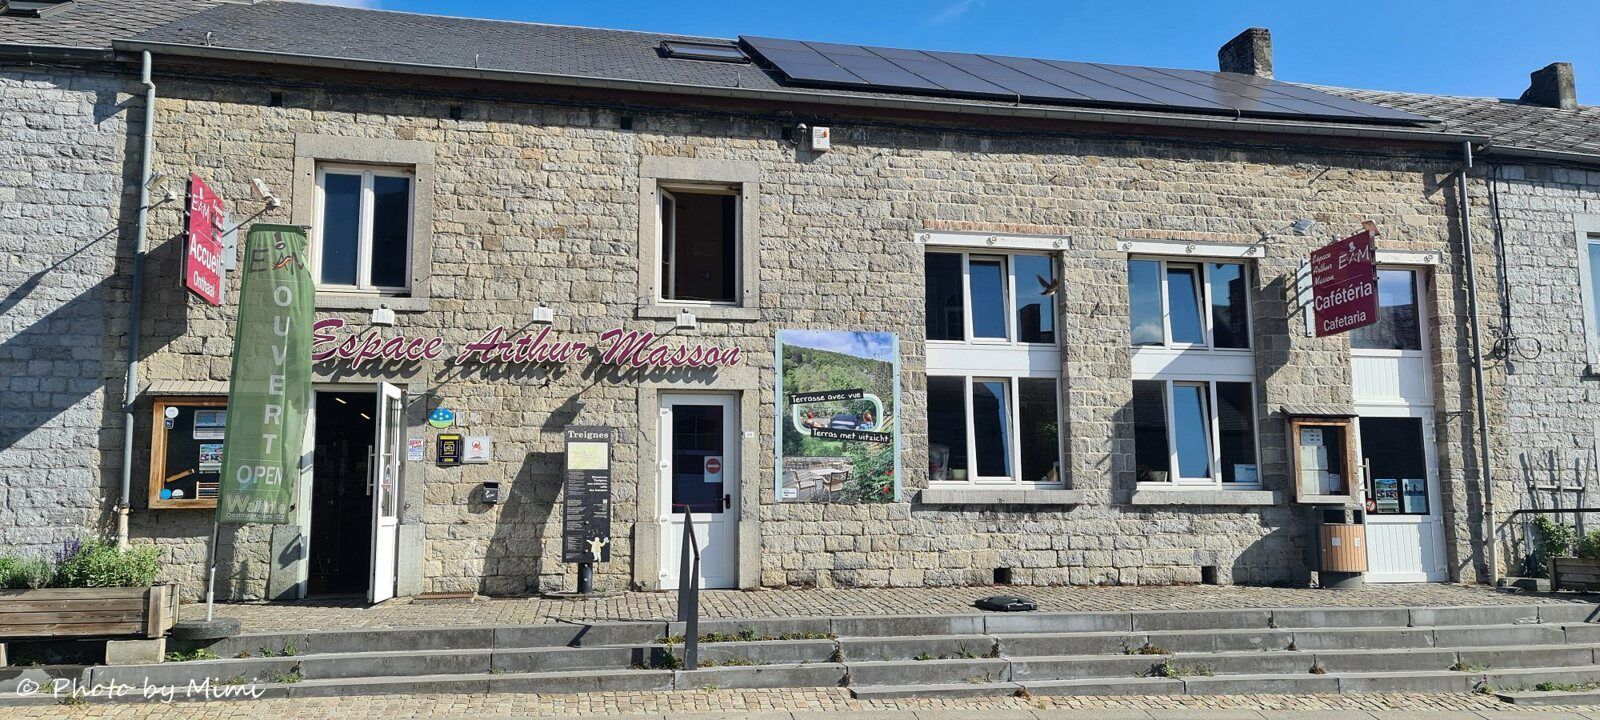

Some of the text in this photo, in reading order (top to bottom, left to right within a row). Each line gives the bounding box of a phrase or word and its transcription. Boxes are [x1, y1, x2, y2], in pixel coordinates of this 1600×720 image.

[189, 233, 221, 277] Accueil
[193, 271, 215, 298] Onthaal
[1315, 281, 1373, 311] Cafétéria
[1323, 310, 1367, 332] Cafetaria
[312, 318, 742, 368] Espace Arthur Masson
[262, 285, 293, 455] OUVERT
[791, 391, 862, 403] Terrasse avec vue
[567, 430, 609, 440] Treignes
[813, 429, 890, 442] Terras met uitzicht
[236, 465, 283, 485] OPEN
